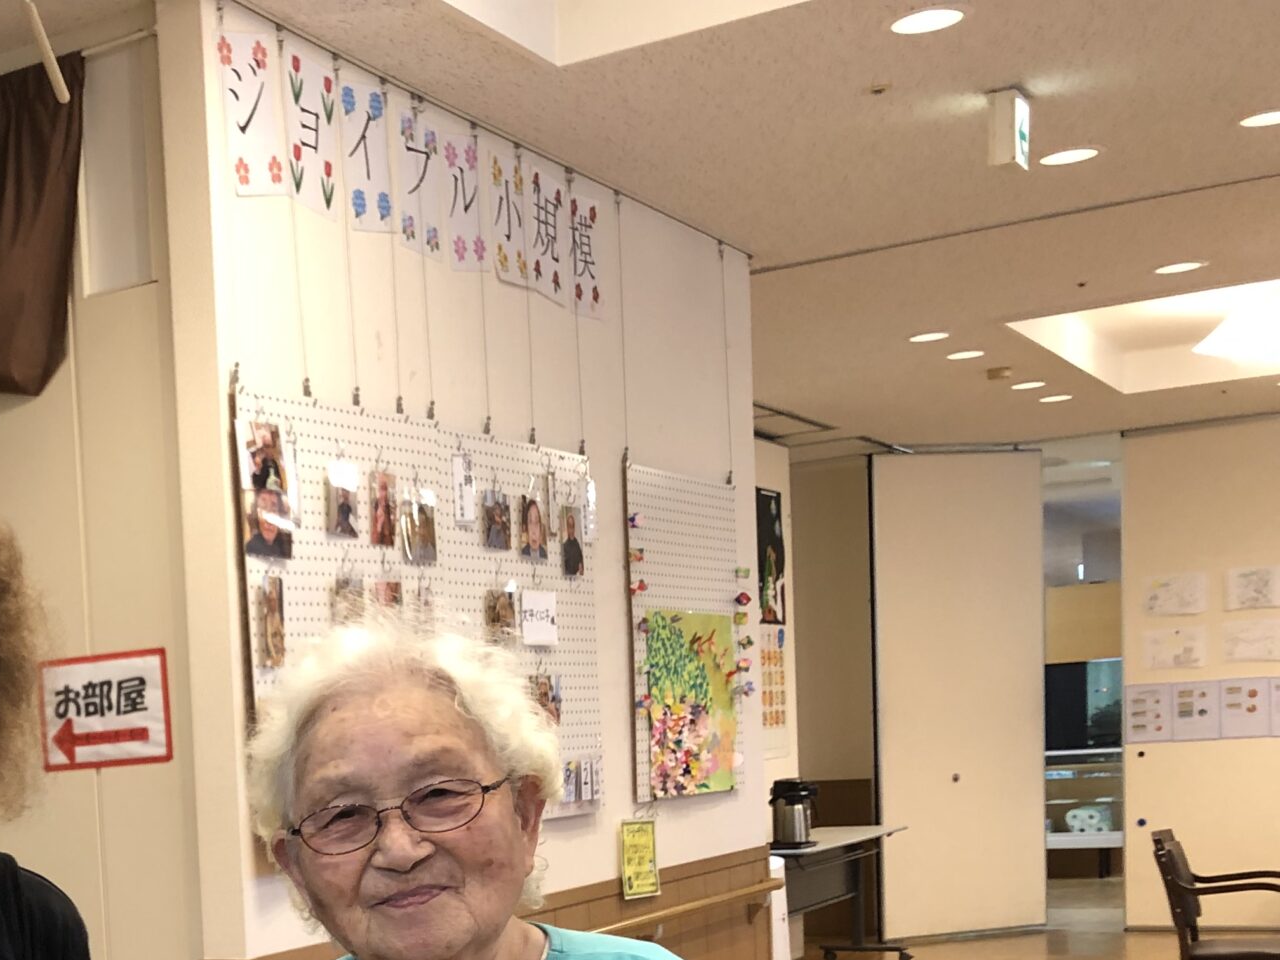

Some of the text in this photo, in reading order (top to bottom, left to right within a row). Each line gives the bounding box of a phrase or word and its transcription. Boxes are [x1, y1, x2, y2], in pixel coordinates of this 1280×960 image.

[227, 57, 597, 281] ジョイフル小規模
[54, 676, 148, 719] お部屋
